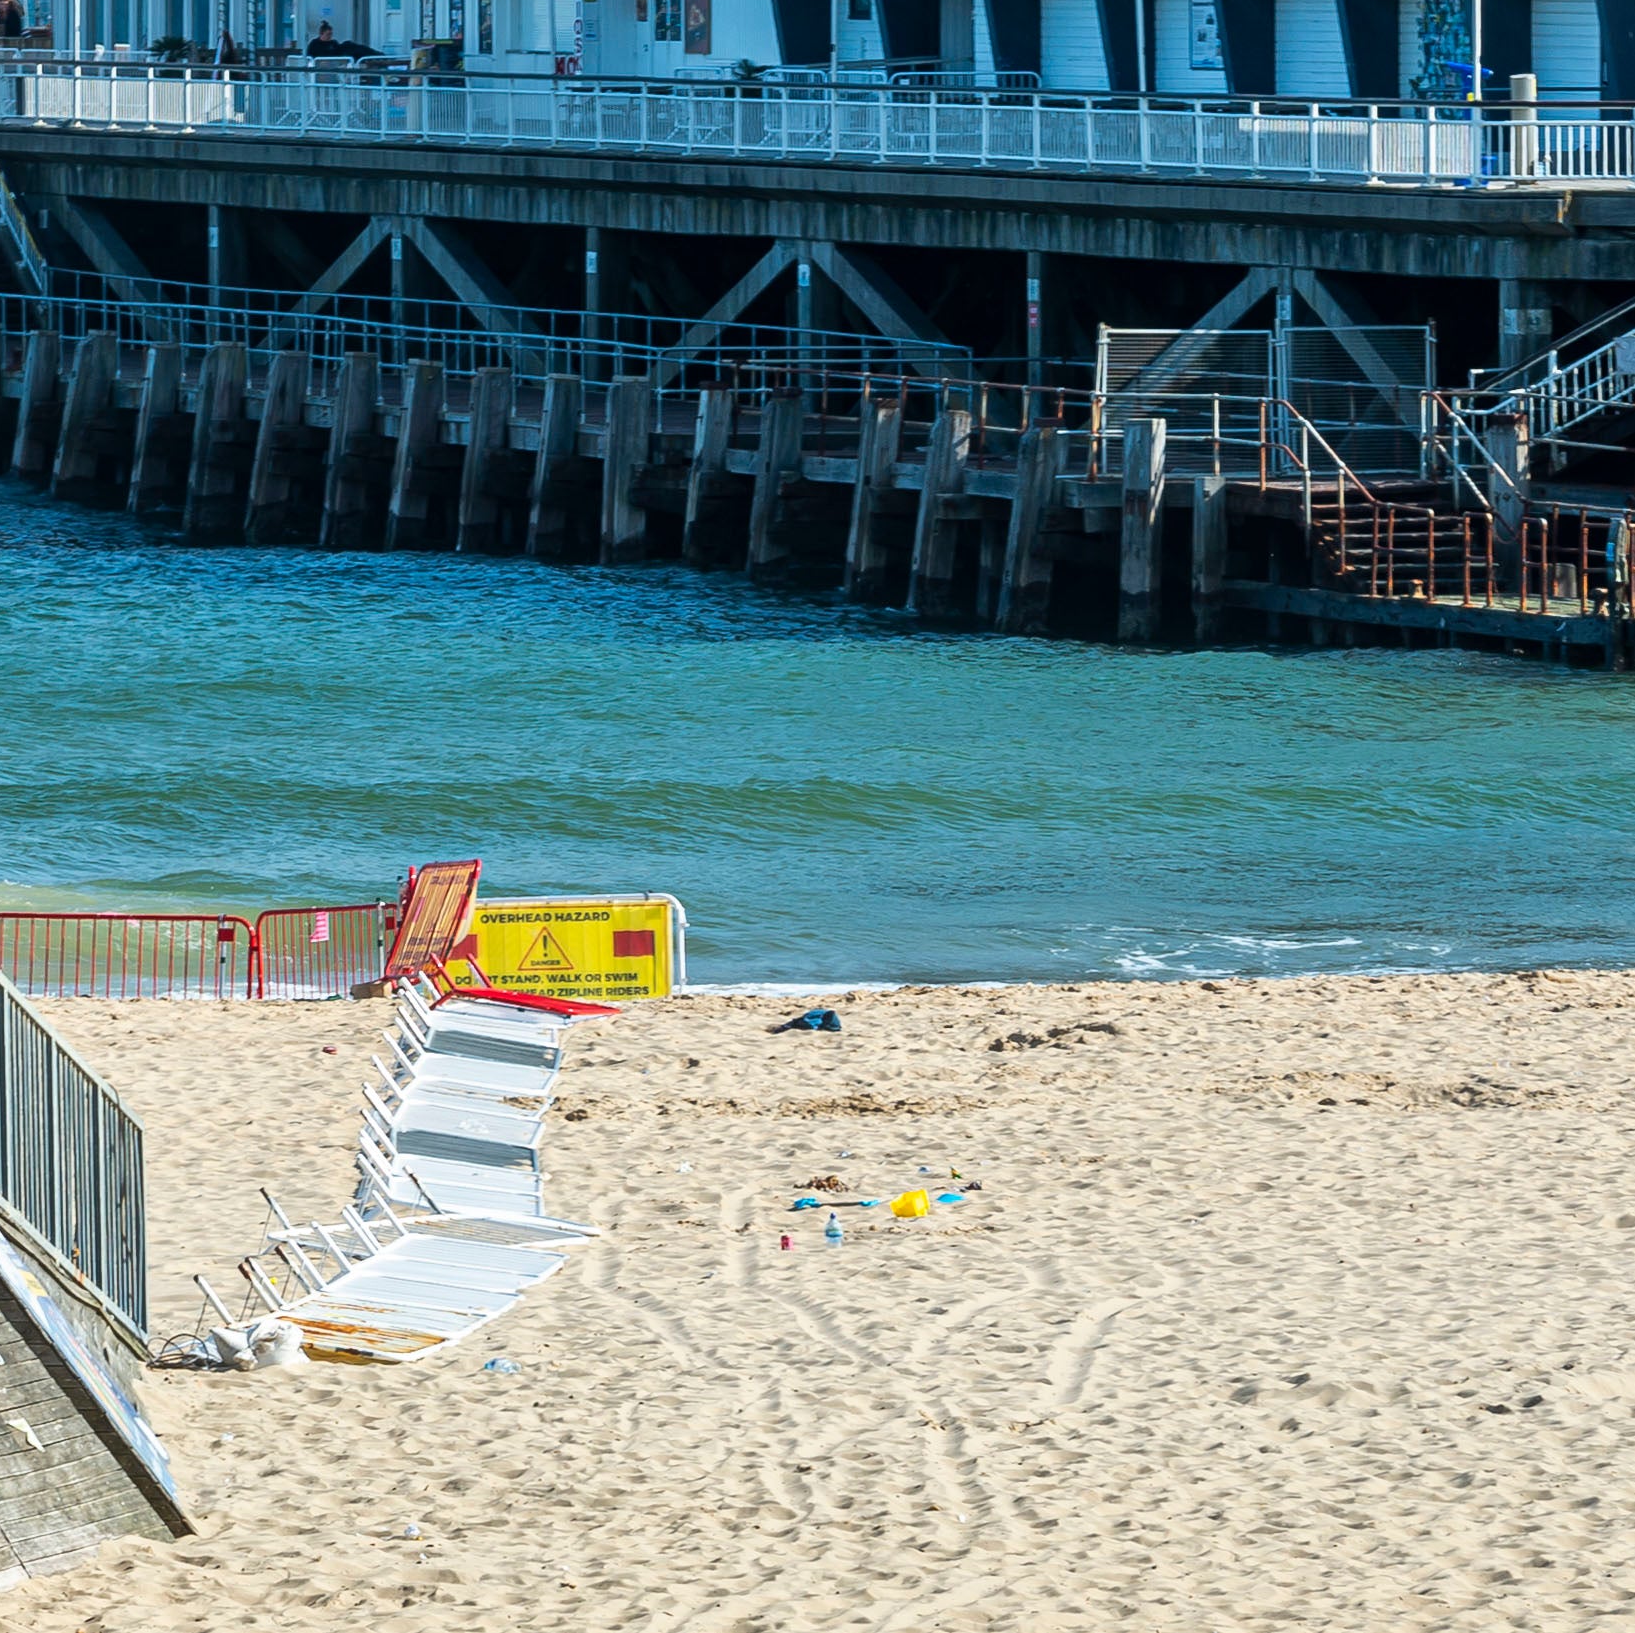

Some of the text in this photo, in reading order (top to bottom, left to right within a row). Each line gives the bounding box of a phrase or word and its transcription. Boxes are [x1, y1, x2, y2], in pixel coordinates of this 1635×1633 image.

[480, 911, 610, 924] OVERHEAD HAZARD
[455, 976, 472, 985] DO
[546, 973, 582, 983] WALK
[585, 973, 602, 983] OR
[604, 972, 639, 982] SWIM
[557, 987, 603, 997] ZIPLINE
[605, 986, 650, 996] RIDERS
